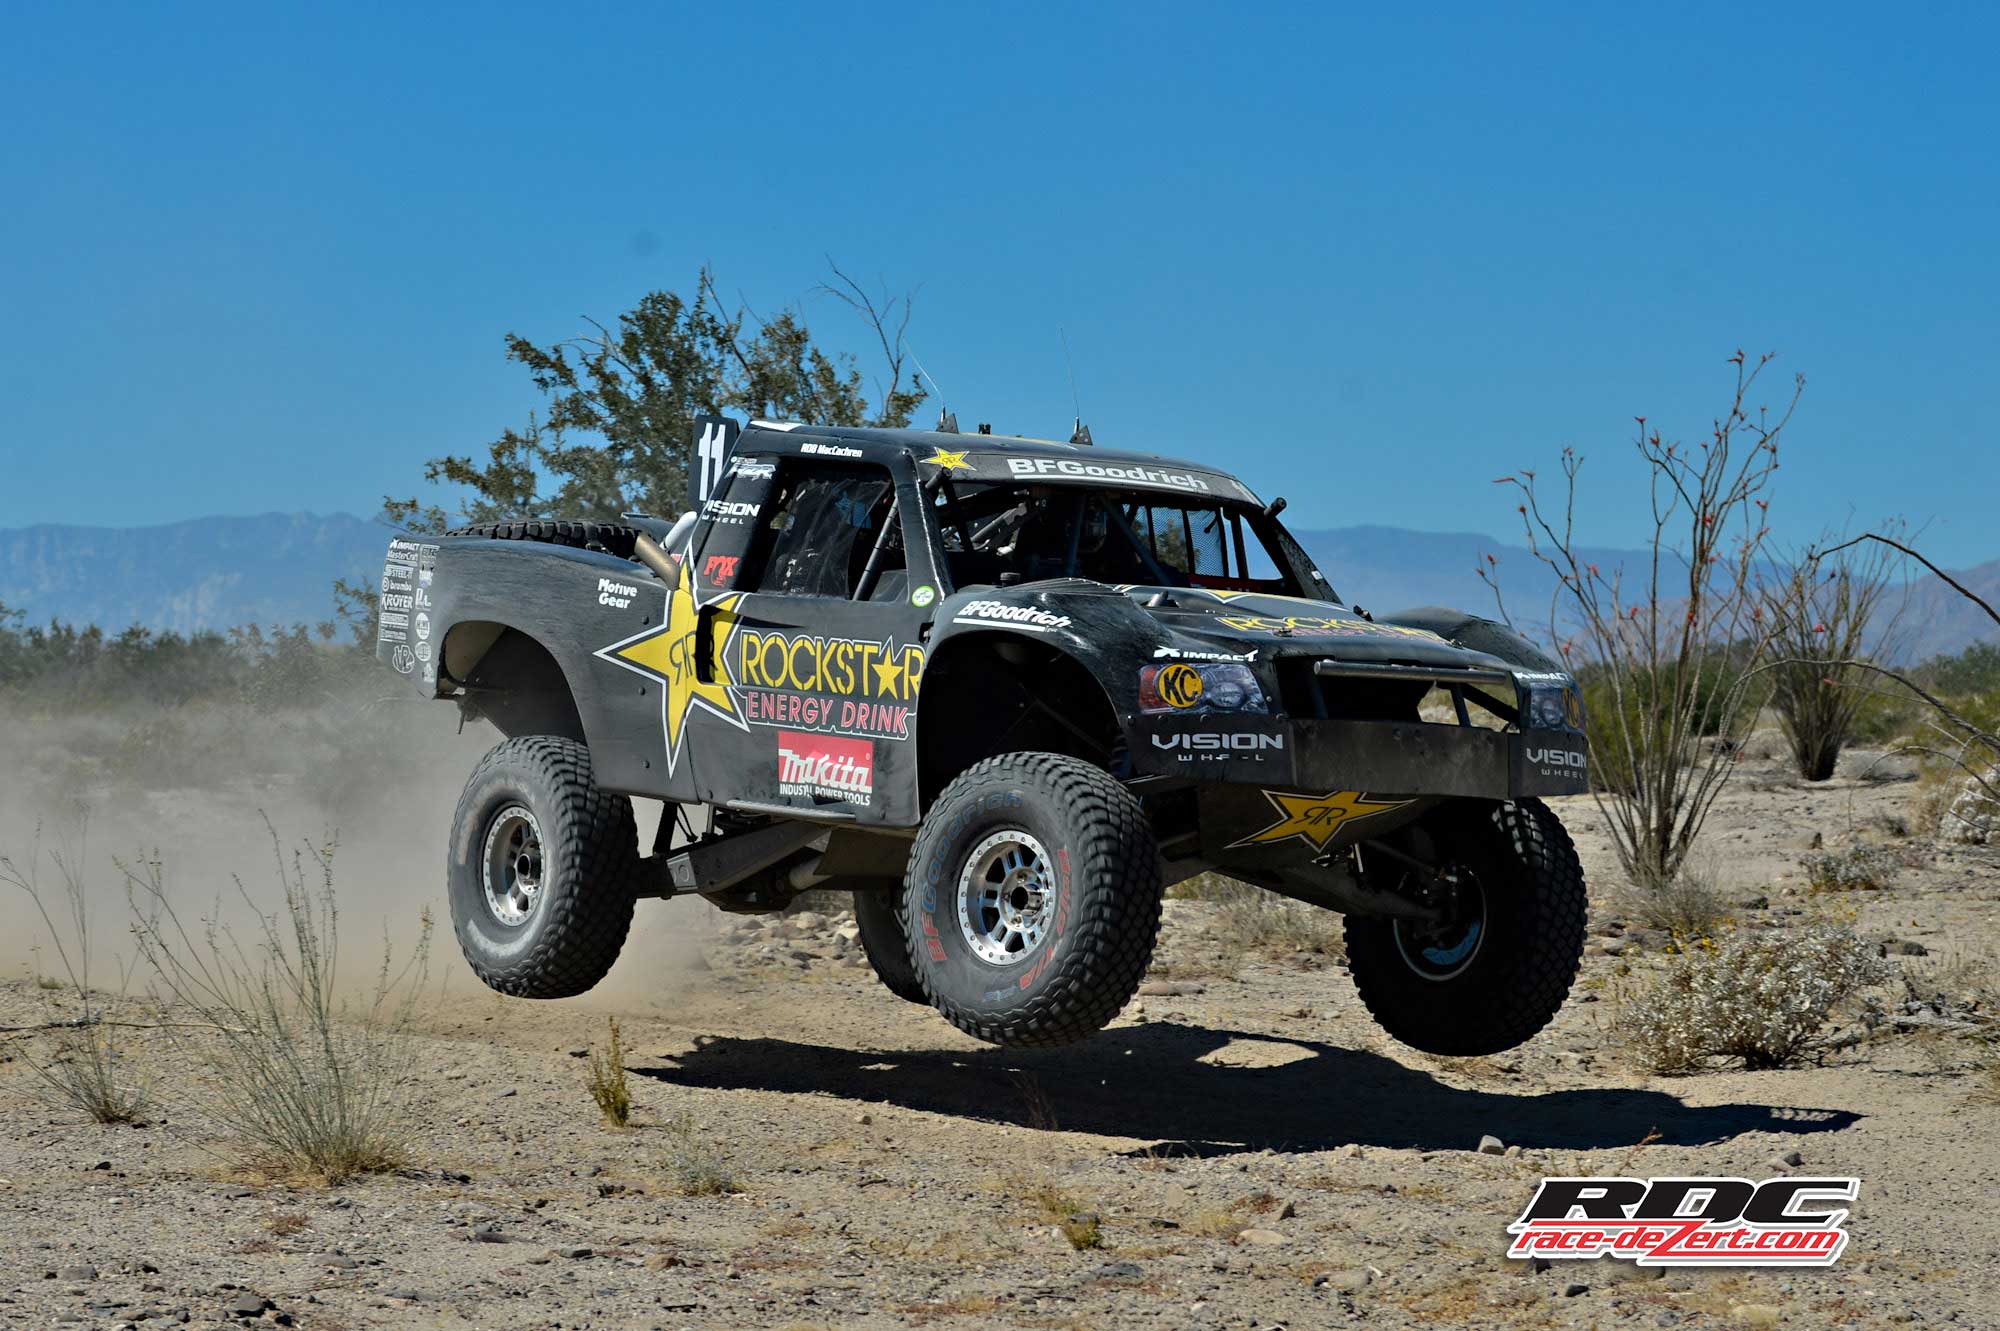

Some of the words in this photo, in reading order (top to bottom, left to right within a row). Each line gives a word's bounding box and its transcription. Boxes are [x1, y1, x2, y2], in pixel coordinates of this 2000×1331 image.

[801, 443, 818, 453] ROB
[698, 423, 726, 500] 11
[1007, 459, 1209, 490] BFGoodrich
[707, 500, 760, 516] ISION
[704, 556, 739, 583] FOX
[598, 578, 637, 597] Motive
[599, 592, 630, 608] Gear
[958, 601, 1072, 628] BFGoodrich
[1183, 650, 1259, 662] IMPACT
[1163, 666, 1199, 705] KC
[747, 692, 833, 726] ENERGY
[840, 701, 908, 734] DRINK
[1152, 734, 1283, 750] VISION
[1526, 747, 1587, 769] VISION
[815, 786, 843, 799] POWER
[843, 792, 870, 806] TOOLS
